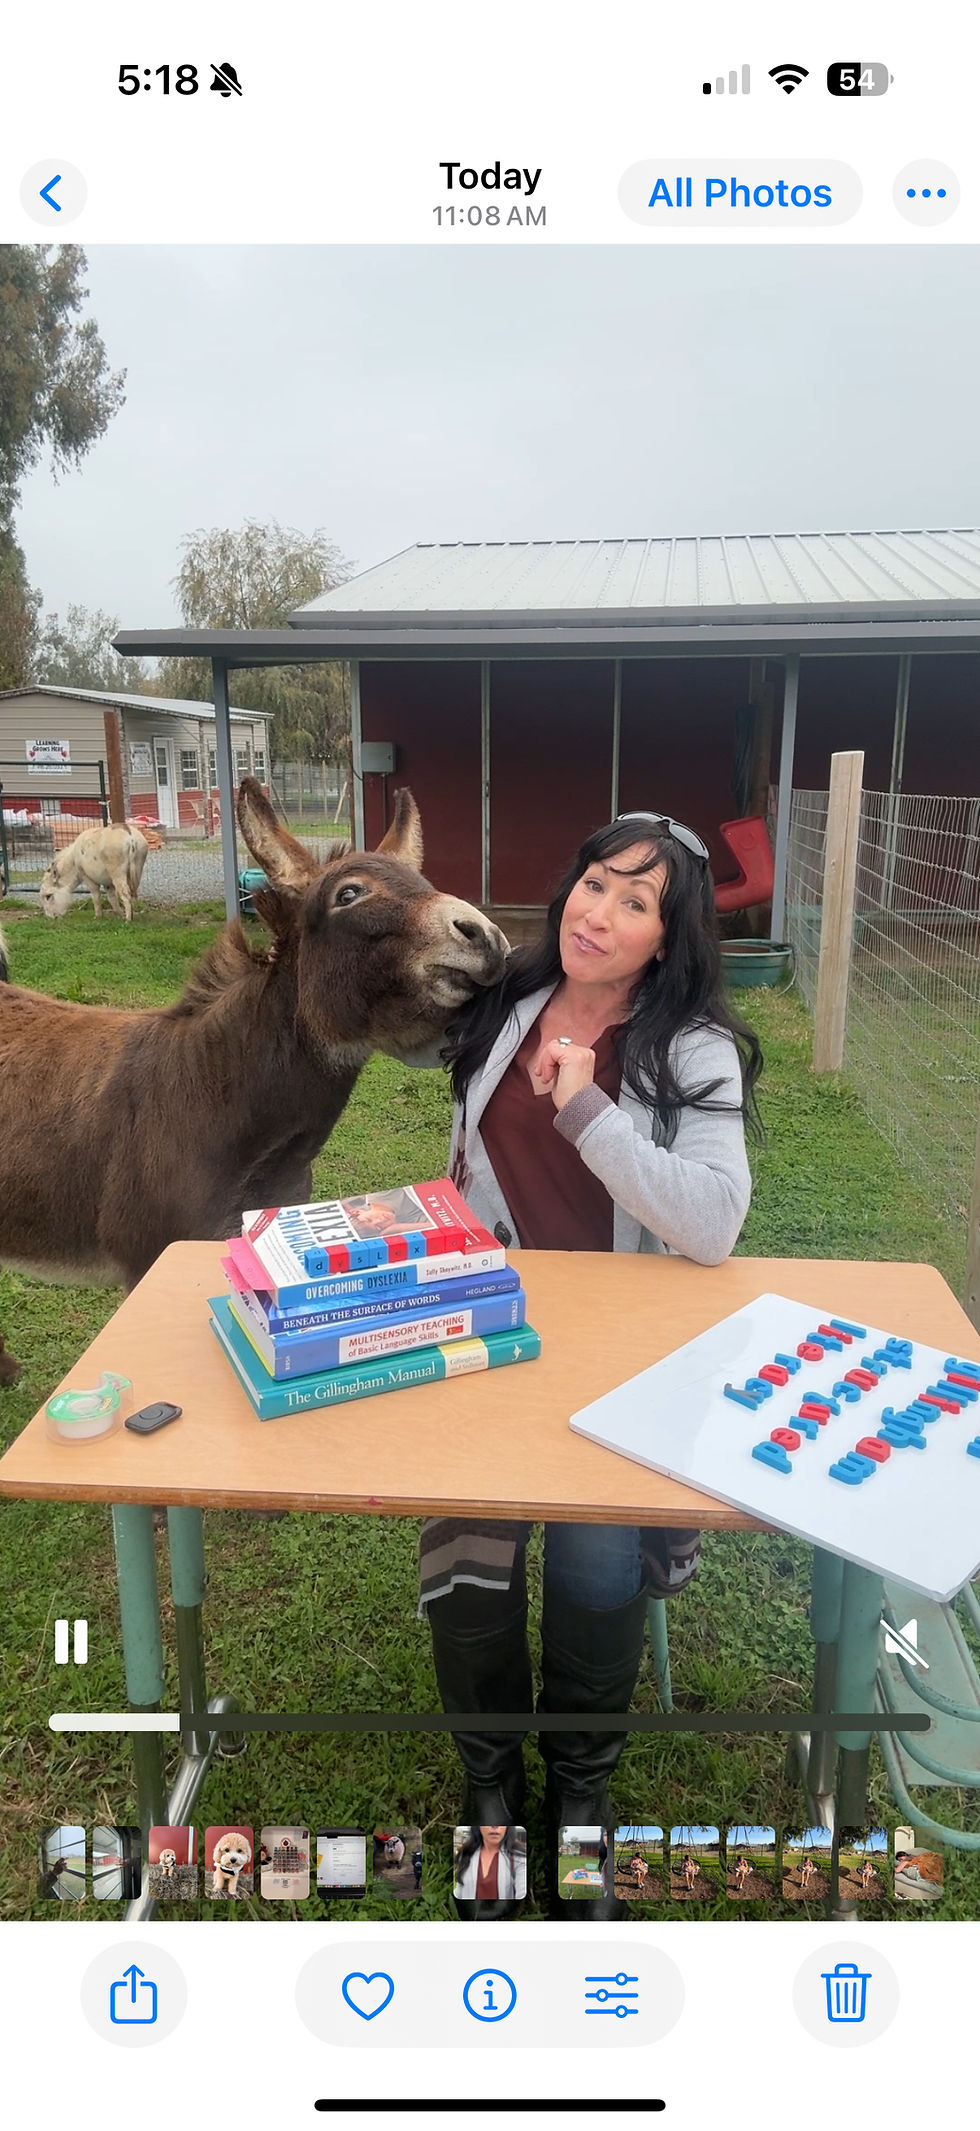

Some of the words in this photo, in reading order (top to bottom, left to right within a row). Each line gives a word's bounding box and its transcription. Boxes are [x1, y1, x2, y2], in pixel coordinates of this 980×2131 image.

[306, 1279, 364, 1300] OVERCOMING
[367, 1271, 408, 1288] DYSLEXIA
[465, 1285, 496, 1297] HEGLAND
[283, 1313, 328, 1329] BENEATH
[330, 1309, 351, 1321] THE
[352, 1303, 394, 1317] SURFACE
[394, 1299, 408, 1310] OF
[408, 1294, 440, 1307] WORDS
[349, 1325, 419, 1347] MULTISENSORY
[421, 1315, 465, 1331] TEACHING
[358, 1345, 378, 1355] Basic
[380, 1337, 417, 1351] Language
[418, 1332, 440, 1344] Skills
[284, 1391, 312, 1407] The
[314, 1376, 384, 1400] Gillingham
[388, 1361, 436, 1384] Manual
